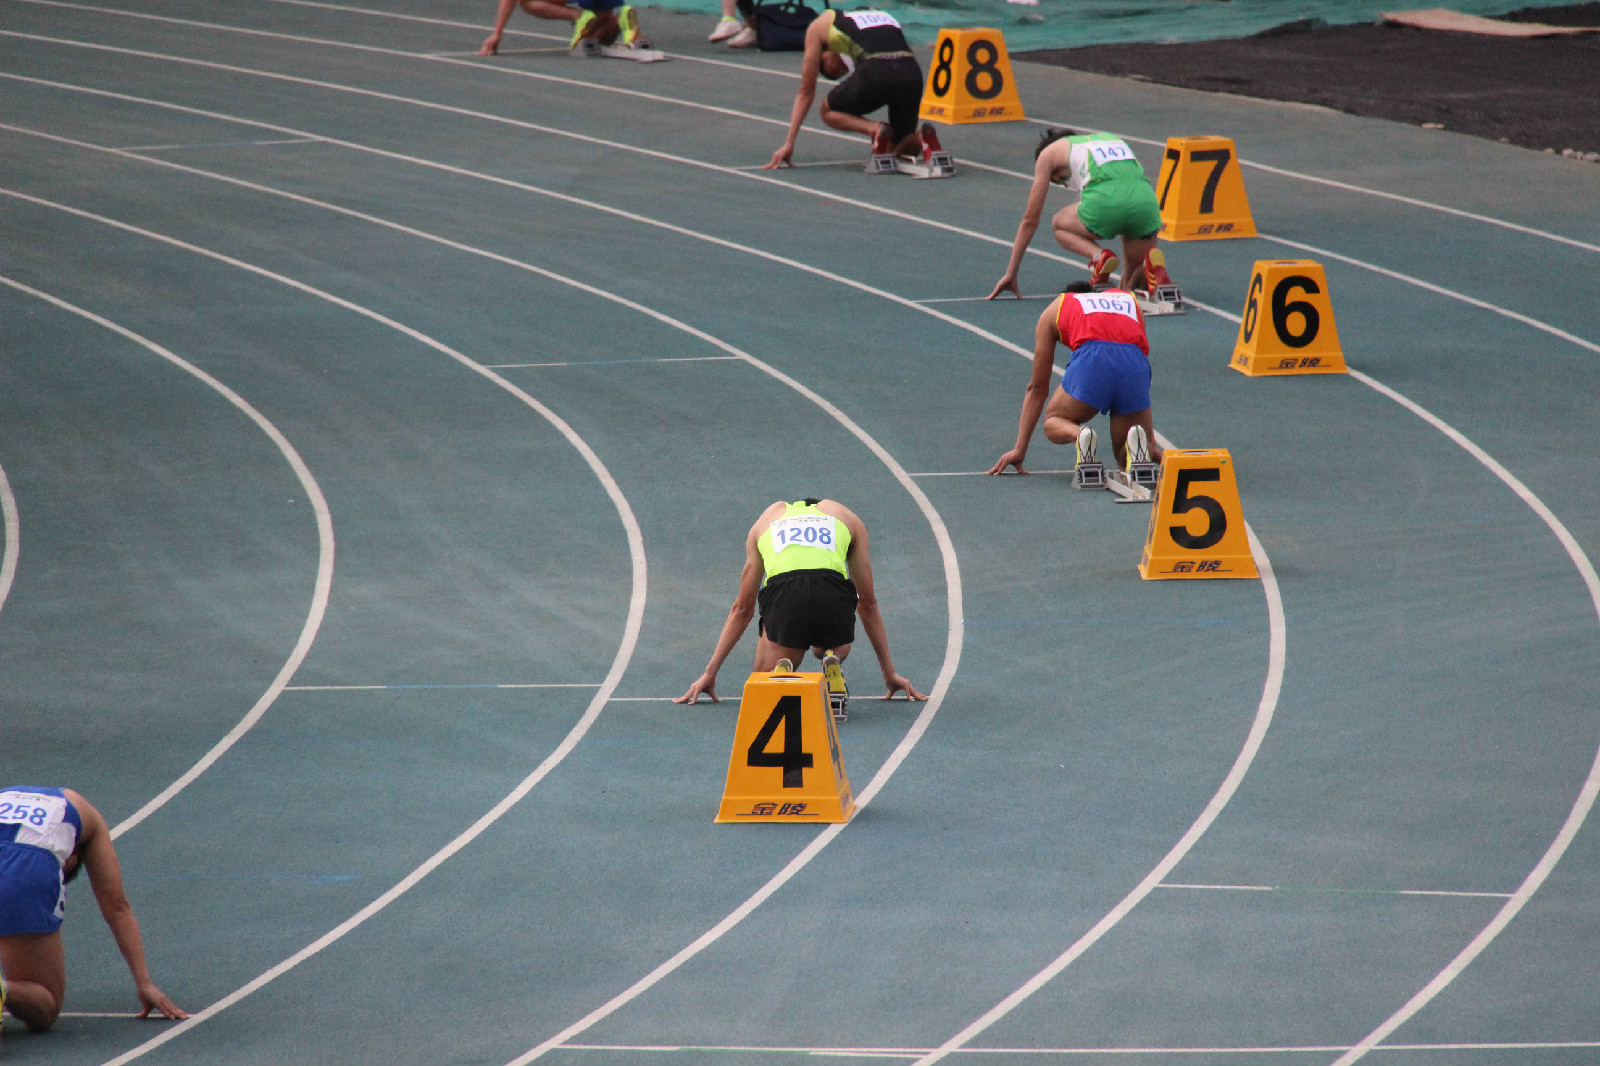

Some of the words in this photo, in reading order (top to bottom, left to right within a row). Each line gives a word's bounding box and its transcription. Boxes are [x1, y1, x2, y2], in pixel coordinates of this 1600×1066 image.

[933, 38, 954, 97] 8
[965, 40, 1003, 99] 8
[1096, 147, 1126, 159] 147
[1160, 148, 1181, 212] 7
[1190, 149, 1231, 214] 7
[1086, 298, 1131, 314] 1067
[1243, 273, 1262, 344] 6
[1272, 275, 1320, 348] 6
[777, 527, 831, 544] 1208
[1169, 468, 1227, 549] 5
[747, 696, 813, 788] 4
[0, 803, 47, 825] 258
